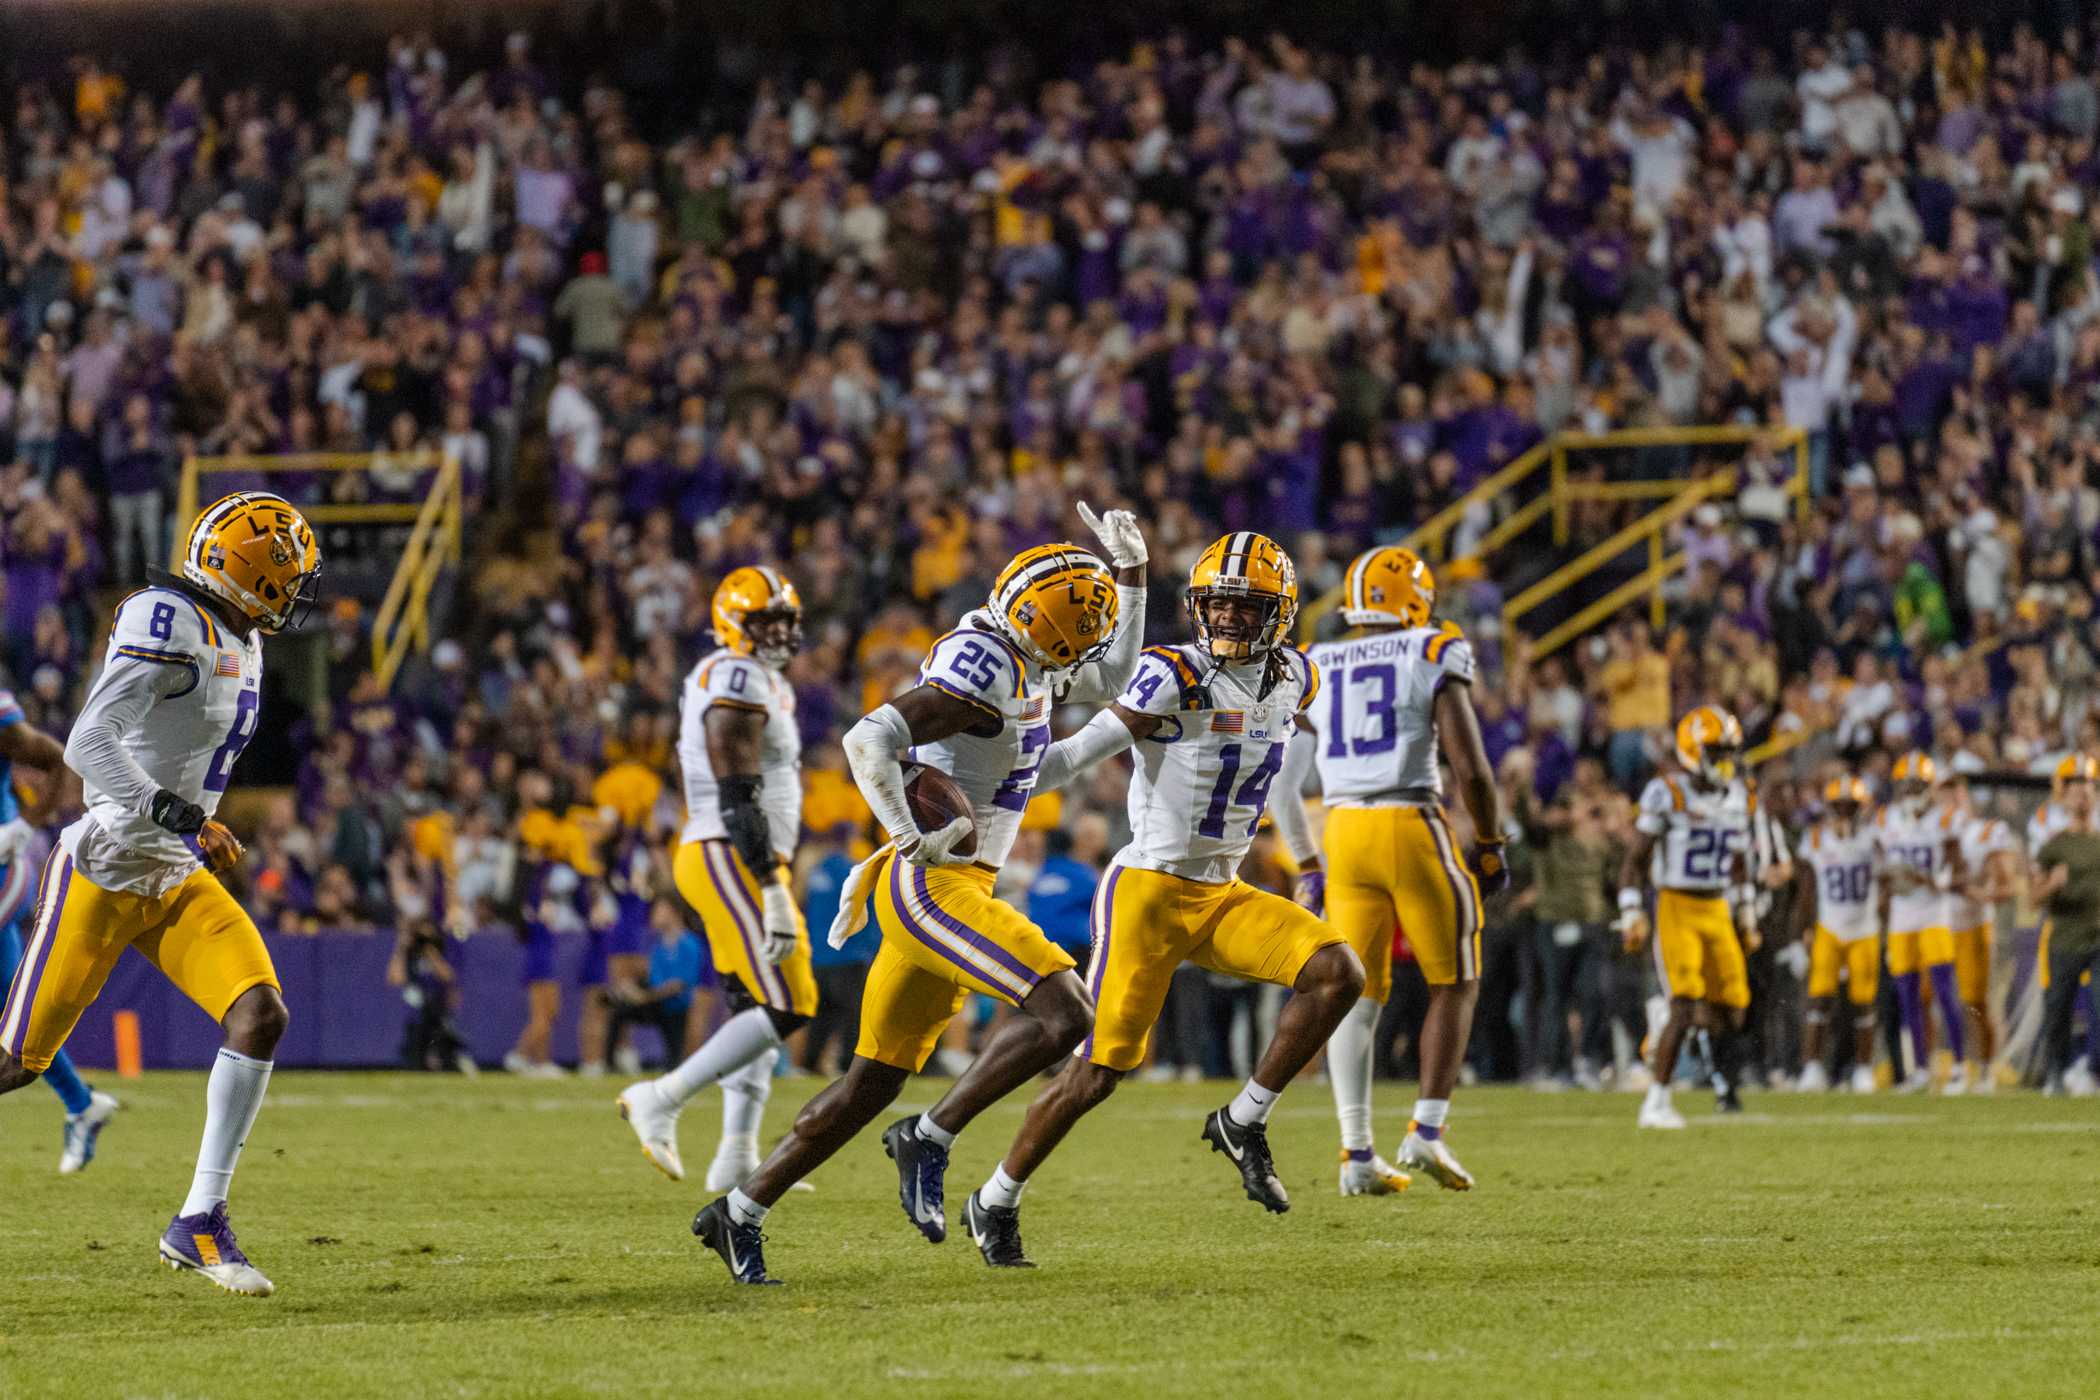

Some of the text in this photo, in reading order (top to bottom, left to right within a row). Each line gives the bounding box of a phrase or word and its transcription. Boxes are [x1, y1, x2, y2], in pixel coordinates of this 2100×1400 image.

[1068, 582, 1115, 620] LSU
[1221, 577, 1242, 585] LSU
[150, 602, 176, 641] 8
[730, 666, 748, 693] 0
[949, 640, 1004, 691] 25
[1126, 663, 1164, 709] 14
[1250, 729, 1269, 739] LSU
[1327, 663, 1397, 759] 13
[203, 689, 258, 793] 8
[992, 724, 1049, 812] 2
[1199, 742, 1285, 839] 14
